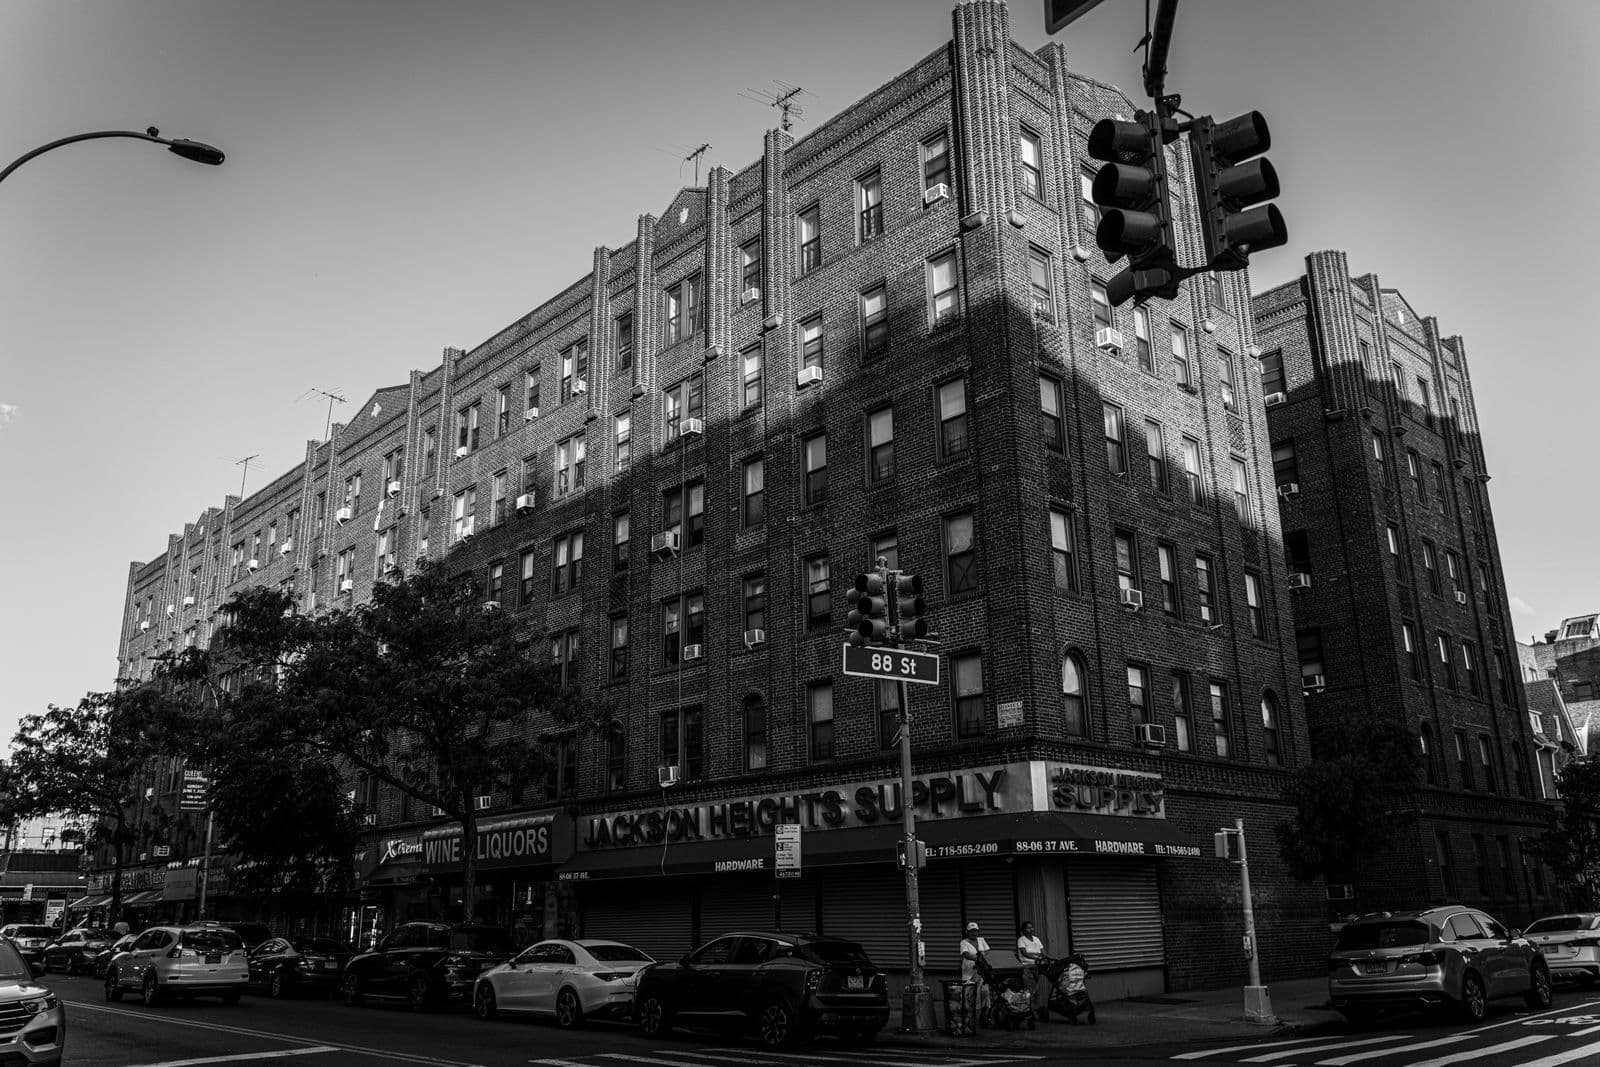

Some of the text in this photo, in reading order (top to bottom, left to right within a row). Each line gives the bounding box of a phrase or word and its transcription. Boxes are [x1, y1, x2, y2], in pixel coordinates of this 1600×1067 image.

[871, 653, 917, 676] 88 St
[1052, 767, 1165, 793] JACKSON HEIGHTS
[584, 769, 1006, 849] JACKSON HEIGHTS SUPPLY
[1053, 784, 1164, 815] SUPPLY
[425, 826, 549, 865] WINE LIQUORS
[925, 842, 998, 857] EL: 718-565-2400
[1015, 840, 1078, 852] 88-06 37 AVE.
[1095, 839, 1145, 855] HARDWARE
[1154, 844, 1166, 854] TEL:
[714, 858, 764, 872] HARDWARE
